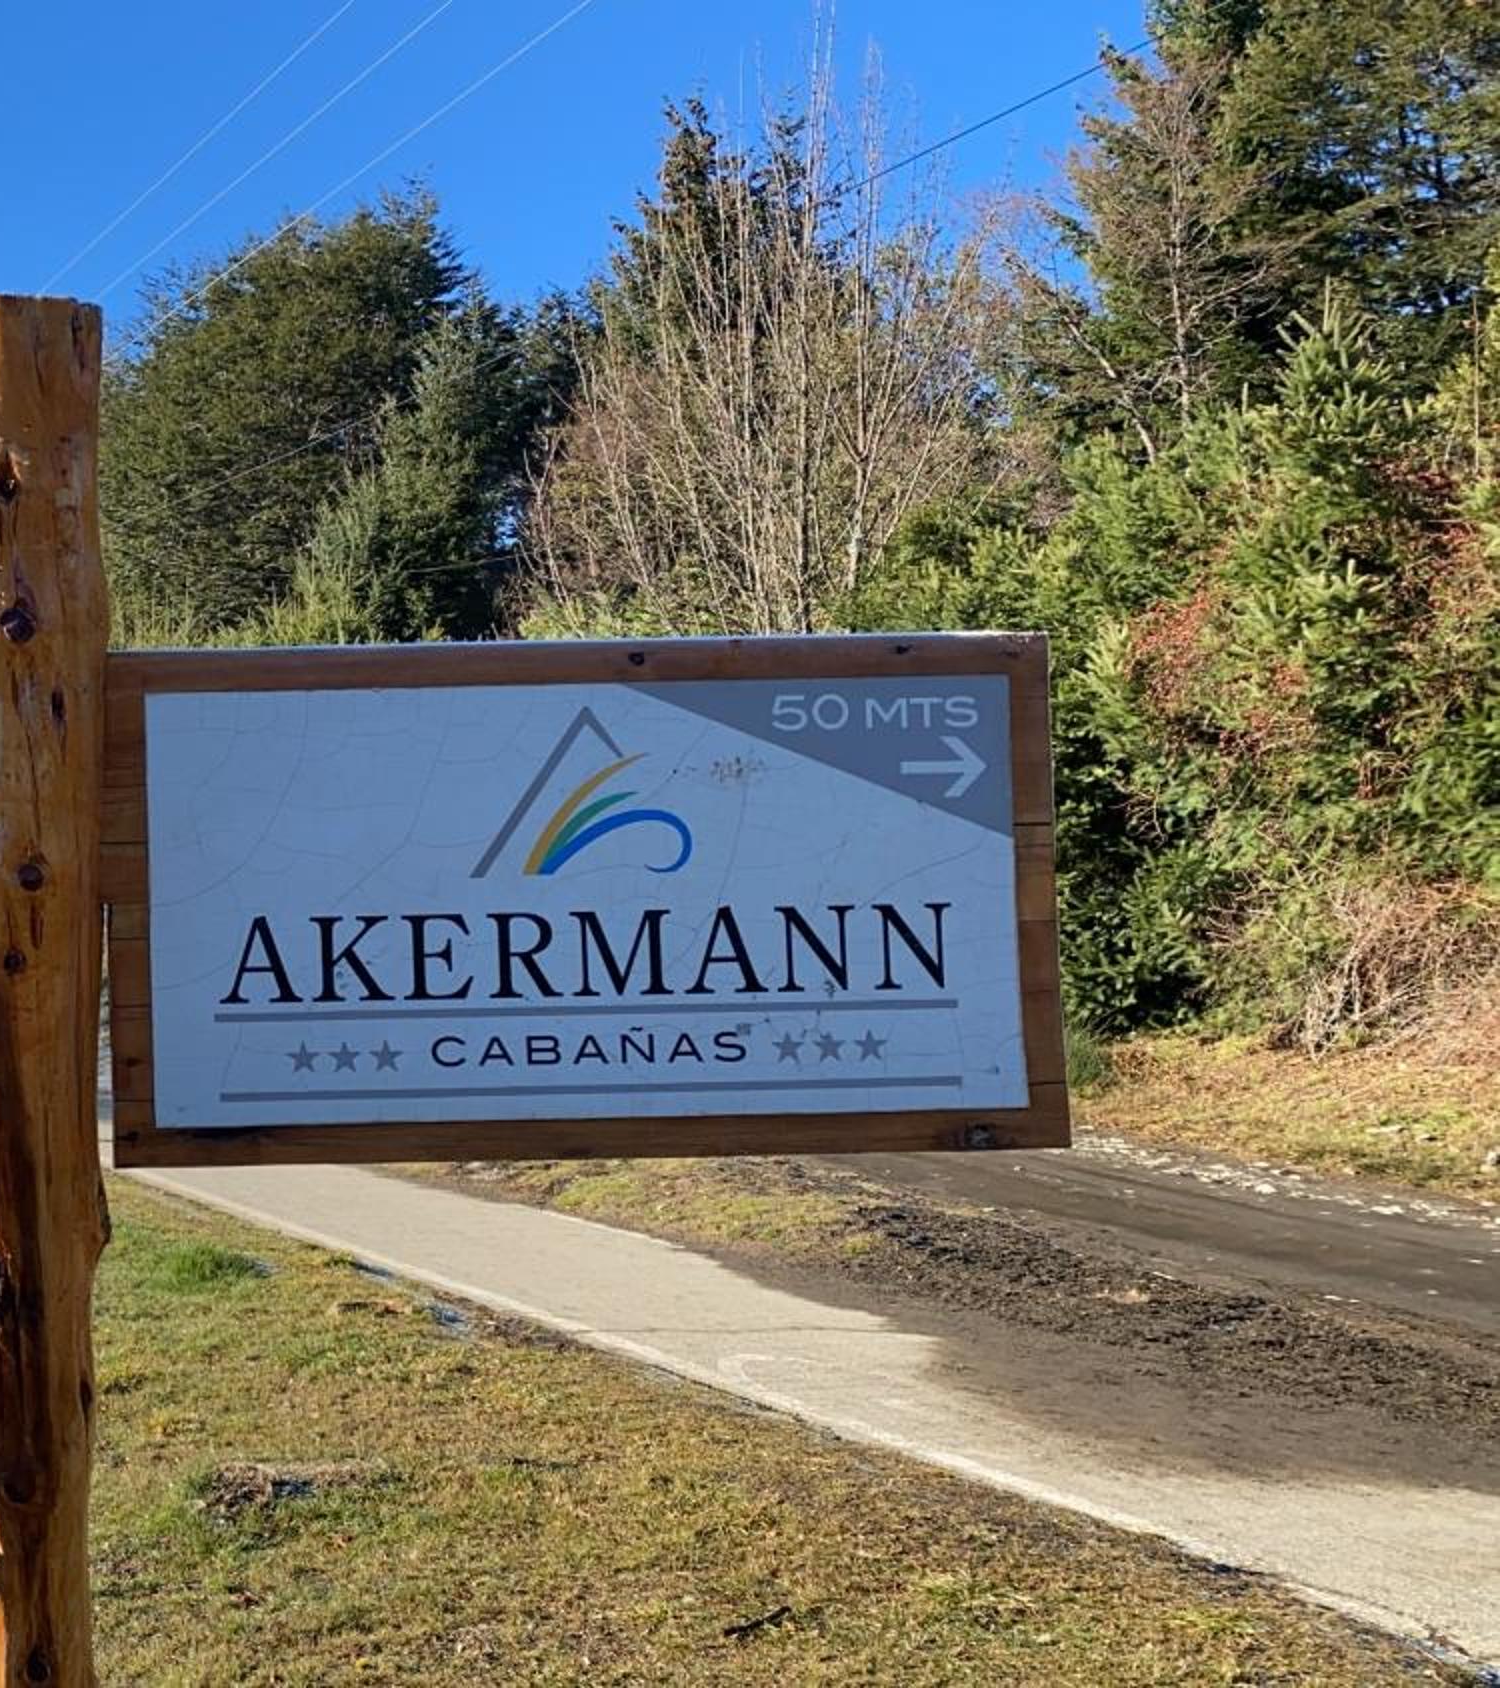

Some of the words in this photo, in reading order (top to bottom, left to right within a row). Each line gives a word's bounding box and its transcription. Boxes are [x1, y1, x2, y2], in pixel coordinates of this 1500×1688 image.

[771, 694, 850, 731] 50
[866, 695, 979, 729] MTS
[219, 902, 951, 1004] AKERMANN
[430, 1026, 747, 1068] CABAÑAS
